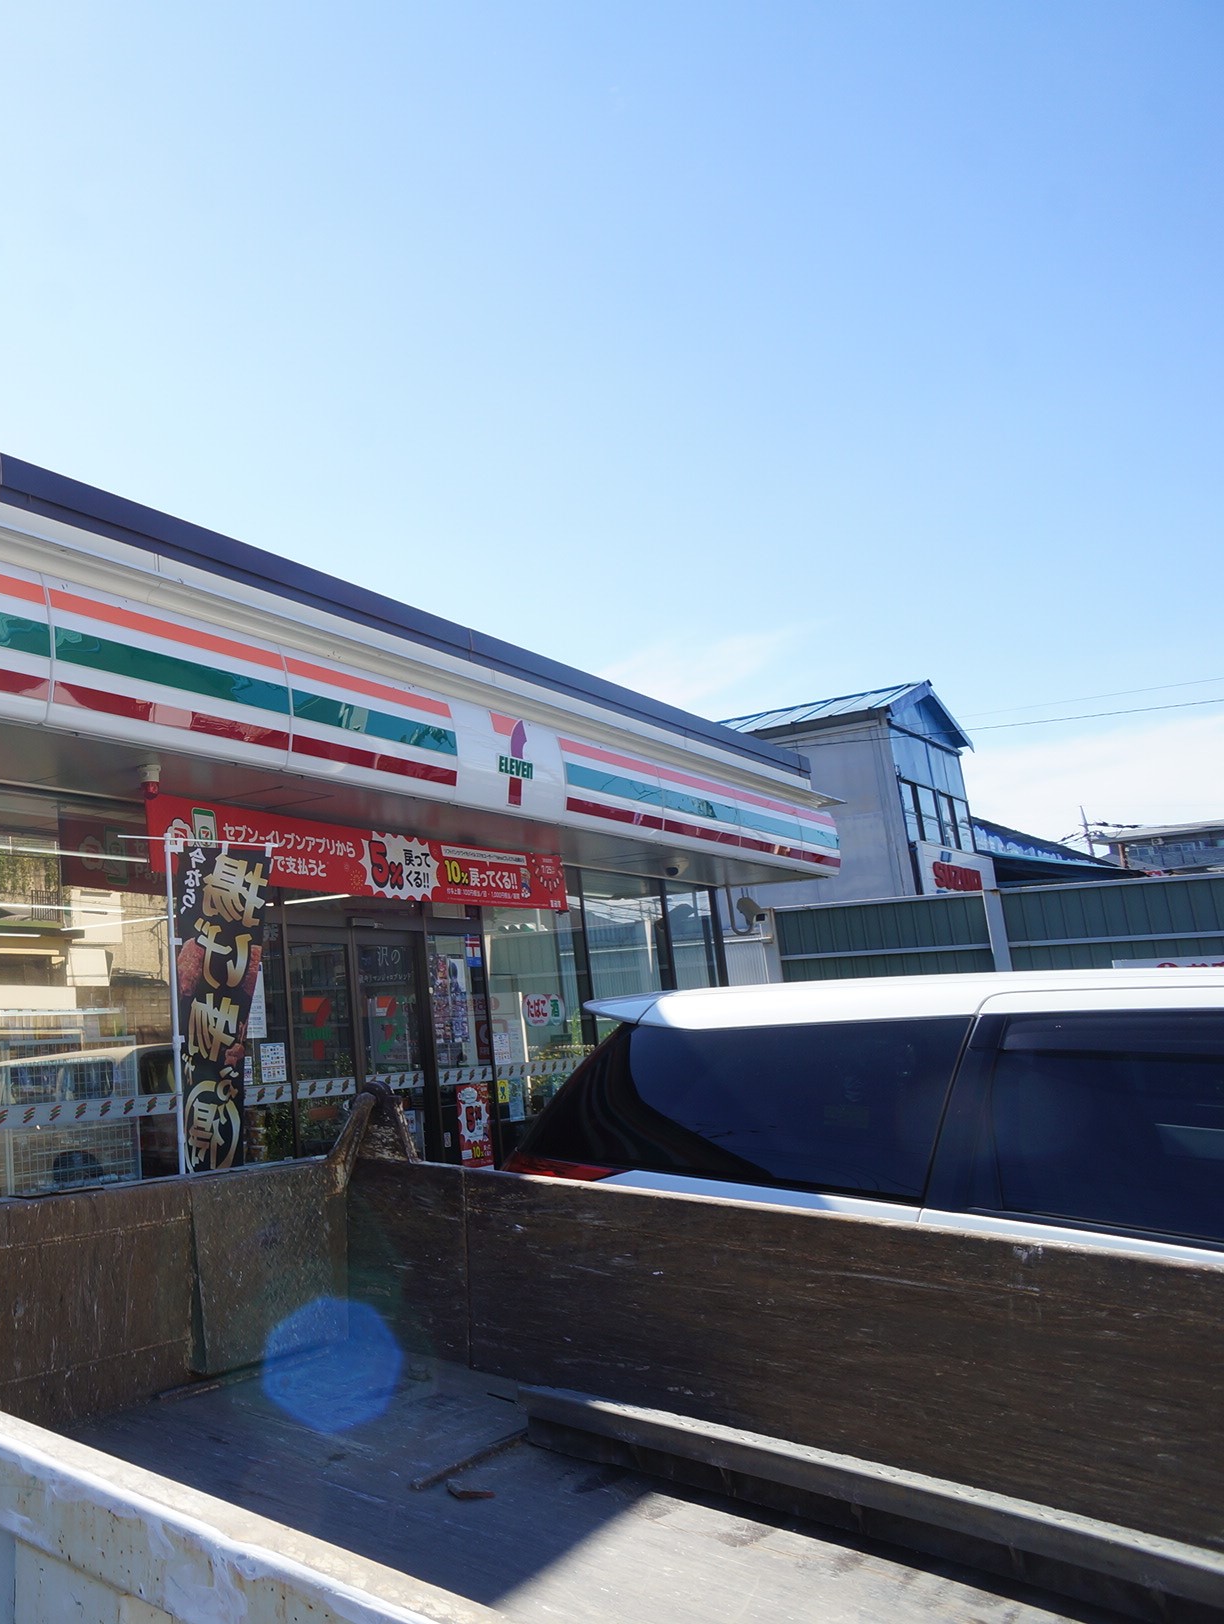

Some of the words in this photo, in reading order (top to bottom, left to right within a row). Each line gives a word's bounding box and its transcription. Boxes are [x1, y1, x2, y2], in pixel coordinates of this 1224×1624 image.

[369, 840, 404, 890] 5%
[403, 849, 431, 868] 戻って
[405, 870, 431, 889] くる!!
[526, 999, 548, 1018] たばこ
